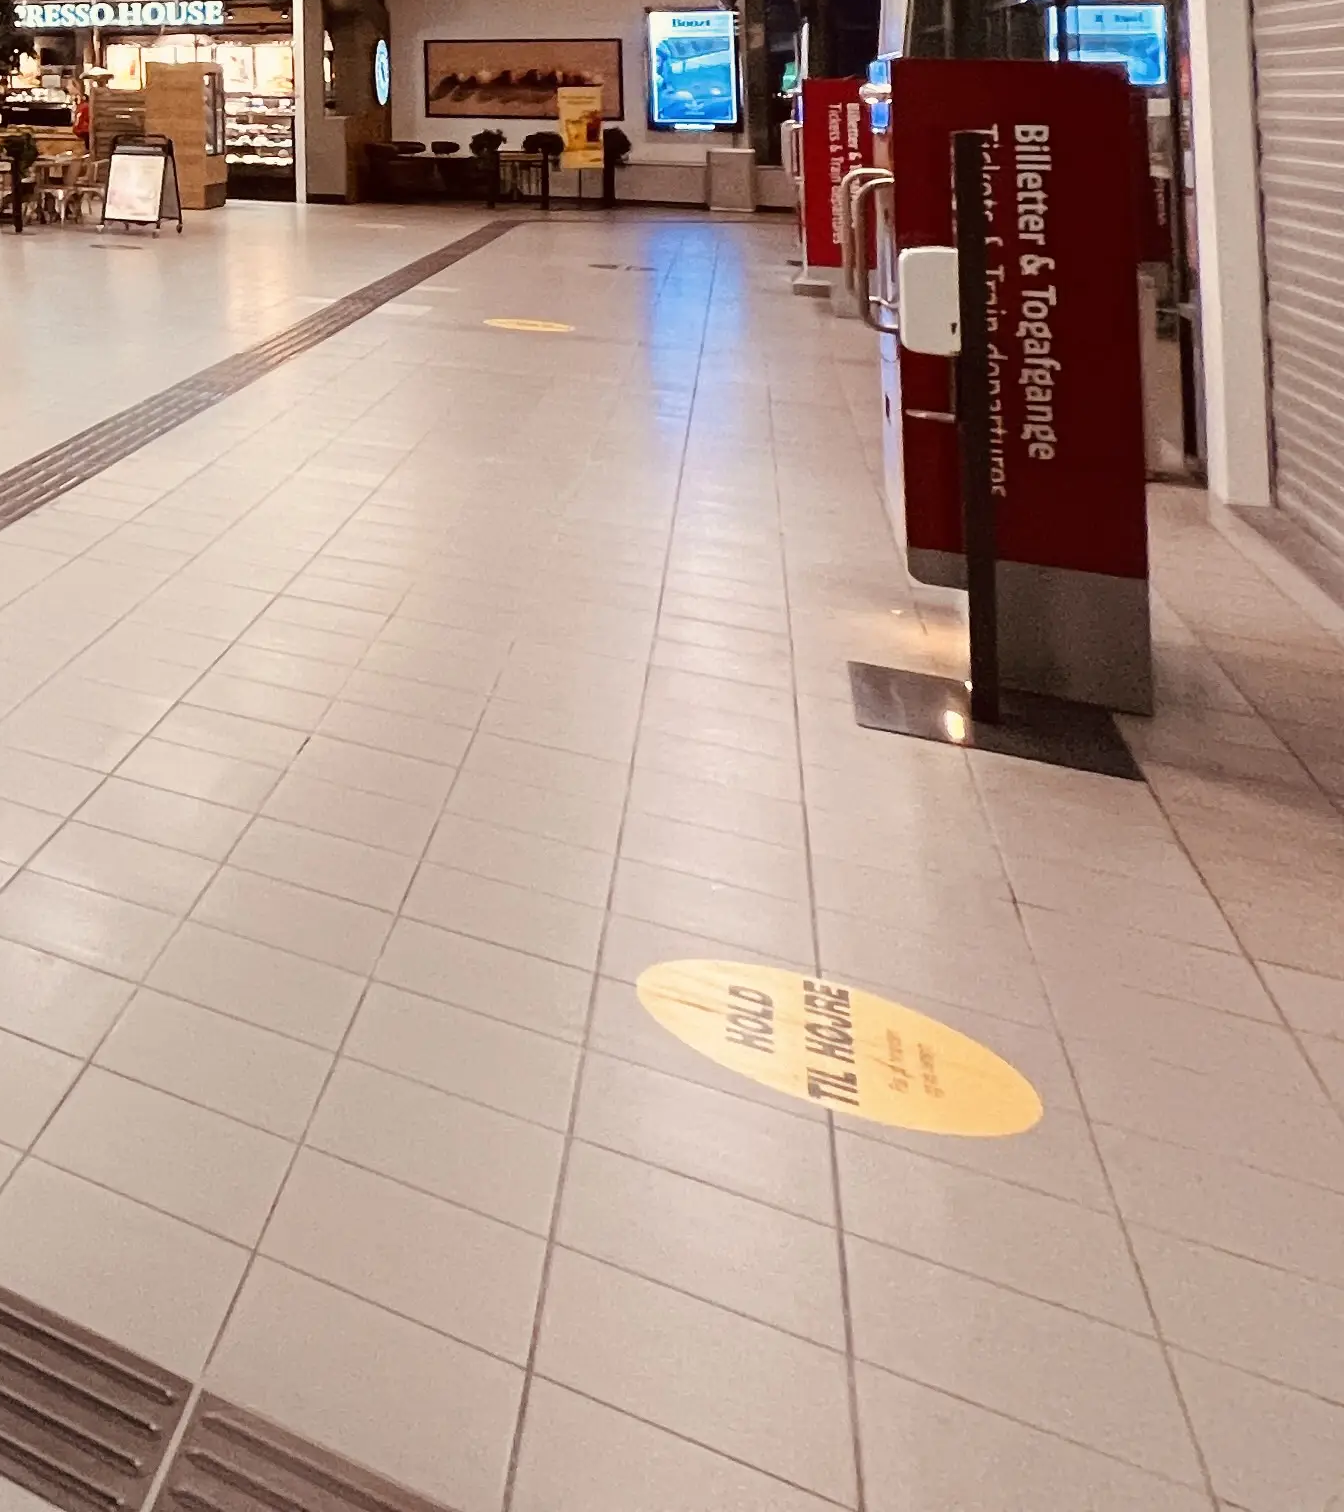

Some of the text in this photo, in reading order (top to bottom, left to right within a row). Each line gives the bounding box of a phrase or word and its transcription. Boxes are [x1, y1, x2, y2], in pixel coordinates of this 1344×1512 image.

[118, 0, 225, 26] HOUSE
[1014, 124, 1061, 461] Billetter & Togafgange
[724, 984, 775, 1054] HOLD
[806, 1066, 860, 1106] TIL
